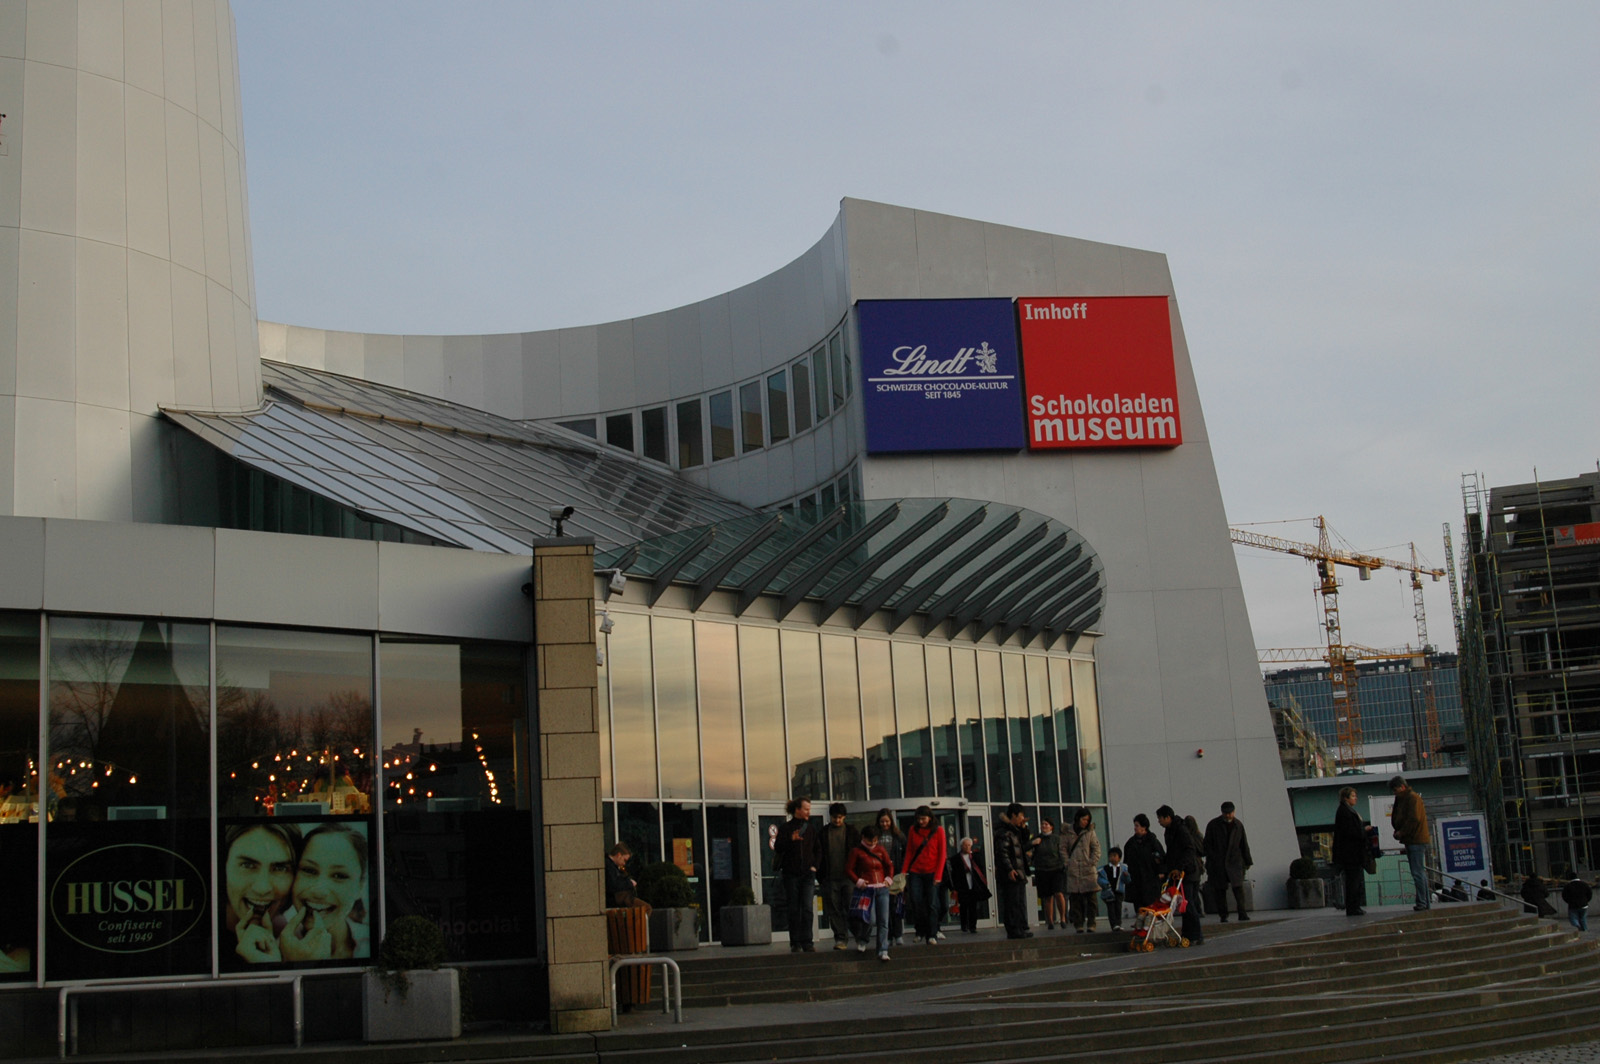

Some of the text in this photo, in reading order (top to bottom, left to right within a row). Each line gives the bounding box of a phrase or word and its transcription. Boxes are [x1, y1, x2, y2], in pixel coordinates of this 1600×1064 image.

[1024, 303, 1088, 320] Imhoff
[883, 345, 975, 375] Lindt
[876, 381, 1009, 392] SCHWEIZER CHOCOLADE-KULTUR
[925, 391, 962, 399] SEIT 1845
[1031, 393, 1175, 416] Schokoladen
[1033, 415, 1177, 442] museum
[66, 879, 194, 915] HUSSEL
[98, 919, 163, 932] Confiserie
[107, 932, 154, 944] seit 1949
